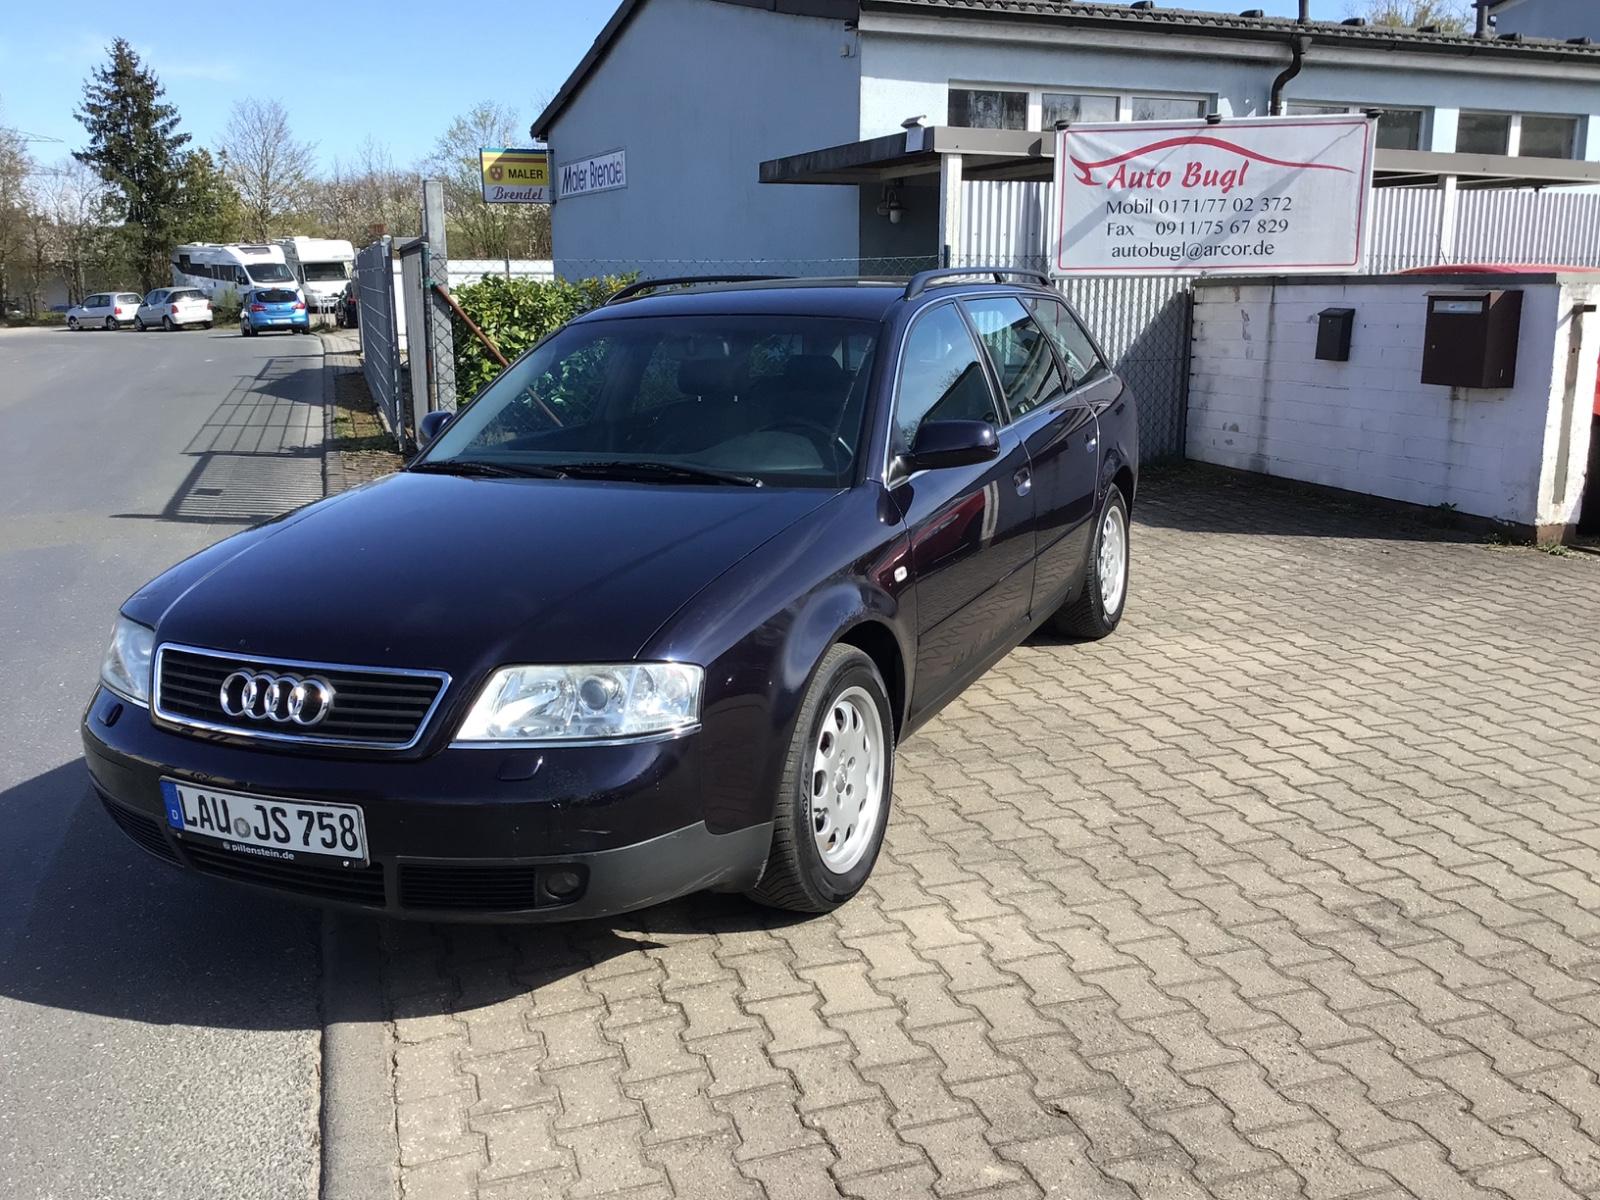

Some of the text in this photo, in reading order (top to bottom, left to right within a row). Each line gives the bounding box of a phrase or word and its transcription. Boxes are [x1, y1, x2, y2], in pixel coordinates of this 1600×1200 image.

[508, 168, 544, 180] MALER
[590, 154, 624, 188] Brendel
[1106, 159, 1250, 194] Auto Bugl
[493, 185, 544, 200] Brendel
[1106, 196, 1292, 215] Mobil 0171/77 02 372
[1106, 218, 1289, 237] Fax 0911/75 67 829
[1111, 240, 1275, 261] autobugl@arcor.de
[178, 789, 359, 852] LAU JS 758
[231, 844, 295, 860] pillenstein.de
